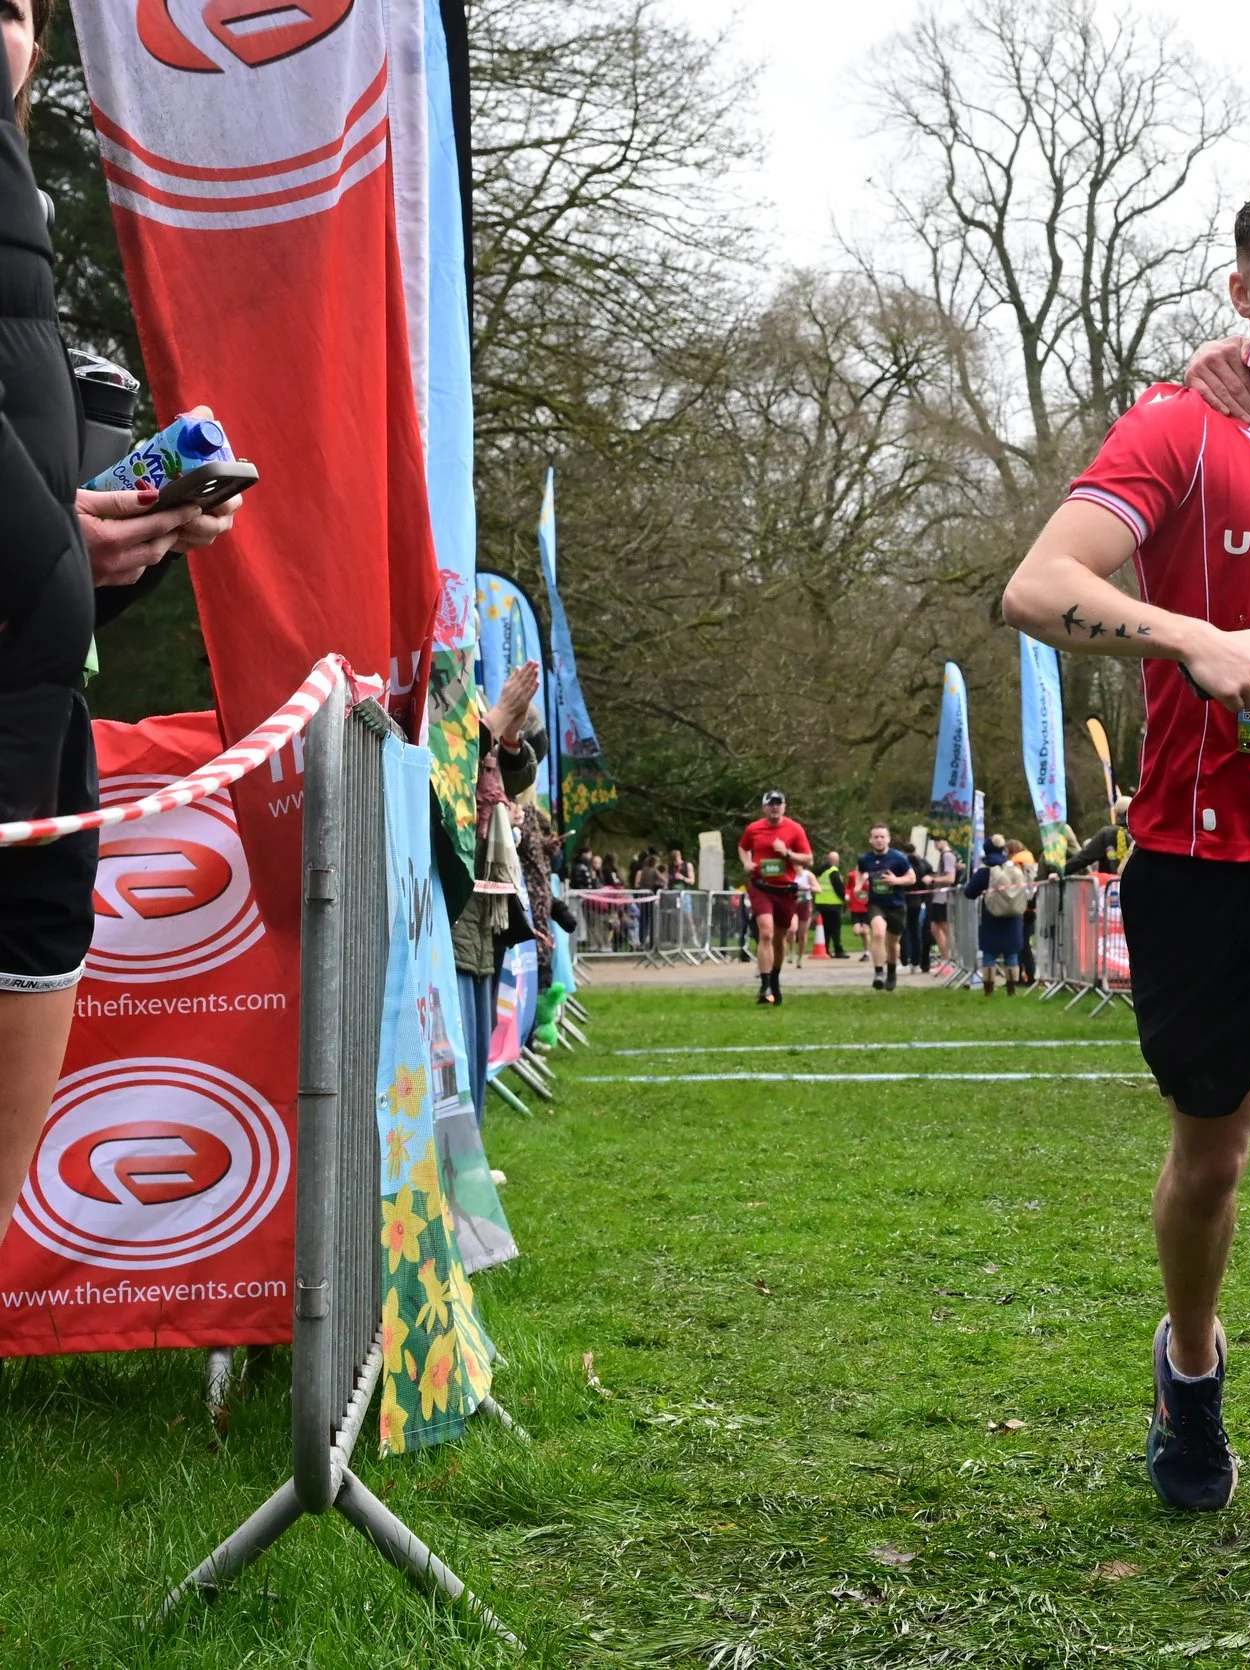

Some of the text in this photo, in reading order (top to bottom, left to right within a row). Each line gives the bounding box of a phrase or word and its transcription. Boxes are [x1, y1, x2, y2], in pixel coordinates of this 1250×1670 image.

[142, 443, 164, 489] VITA
[1037, 760, 1048, 786] Ras
[1, 1280, 286, 1308] www.thefixevents.com
